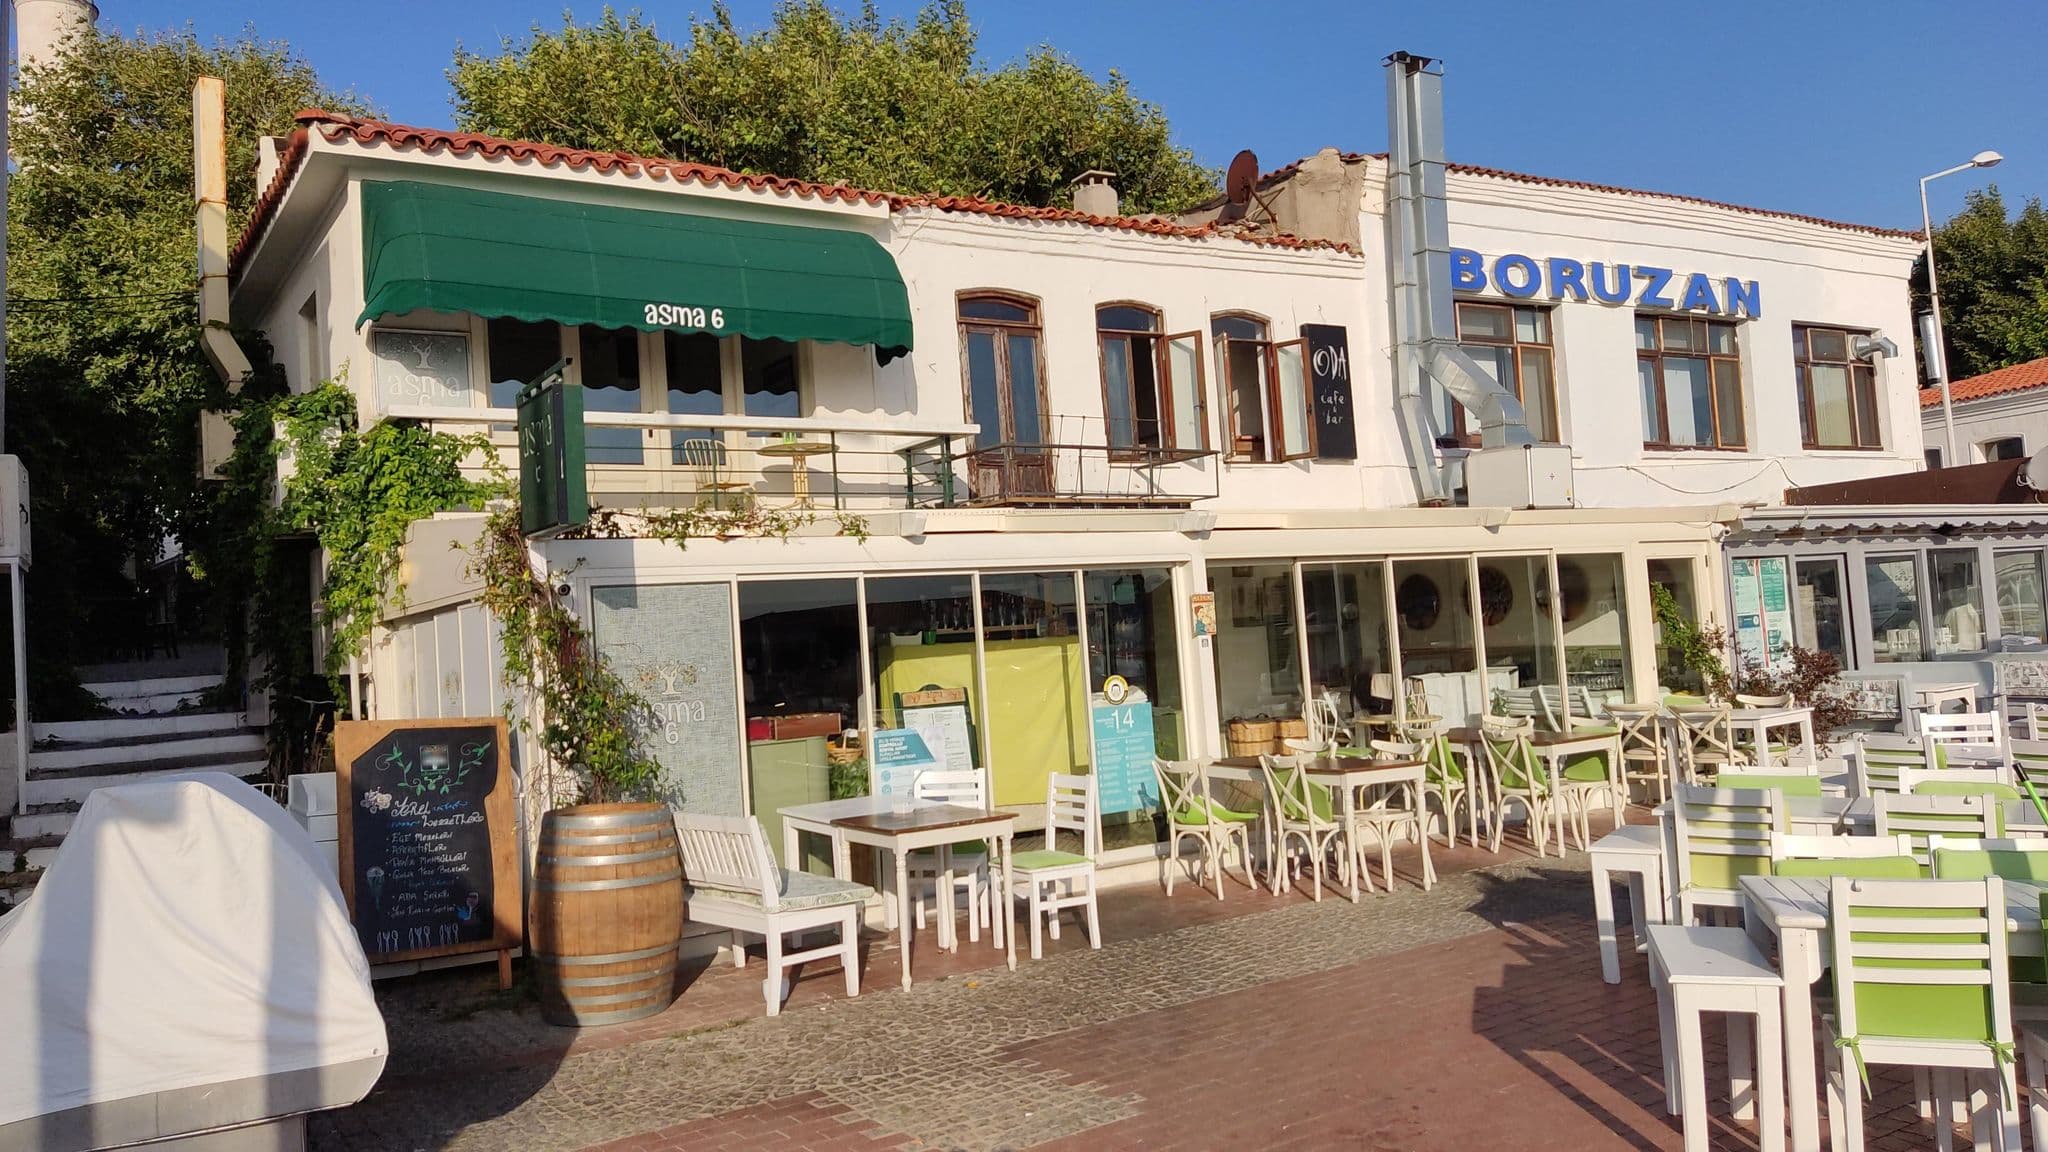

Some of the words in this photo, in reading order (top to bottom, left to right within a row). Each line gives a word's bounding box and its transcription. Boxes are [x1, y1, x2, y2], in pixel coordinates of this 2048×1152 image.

[1450, 247, 1761, 322] BORUZAN
[644, 303, 706, 328] asma
[711, 308, 725, 329] 6
[1312, 345, 1347, 381] ODA
[387, 374, 460, 397] asma
[1320, 389, 1345, 405] cafe
[1325, 409, 1344, 425] bar
[1111, 708, 1135, 731] 14
[664, 721, 679, 745] 6
